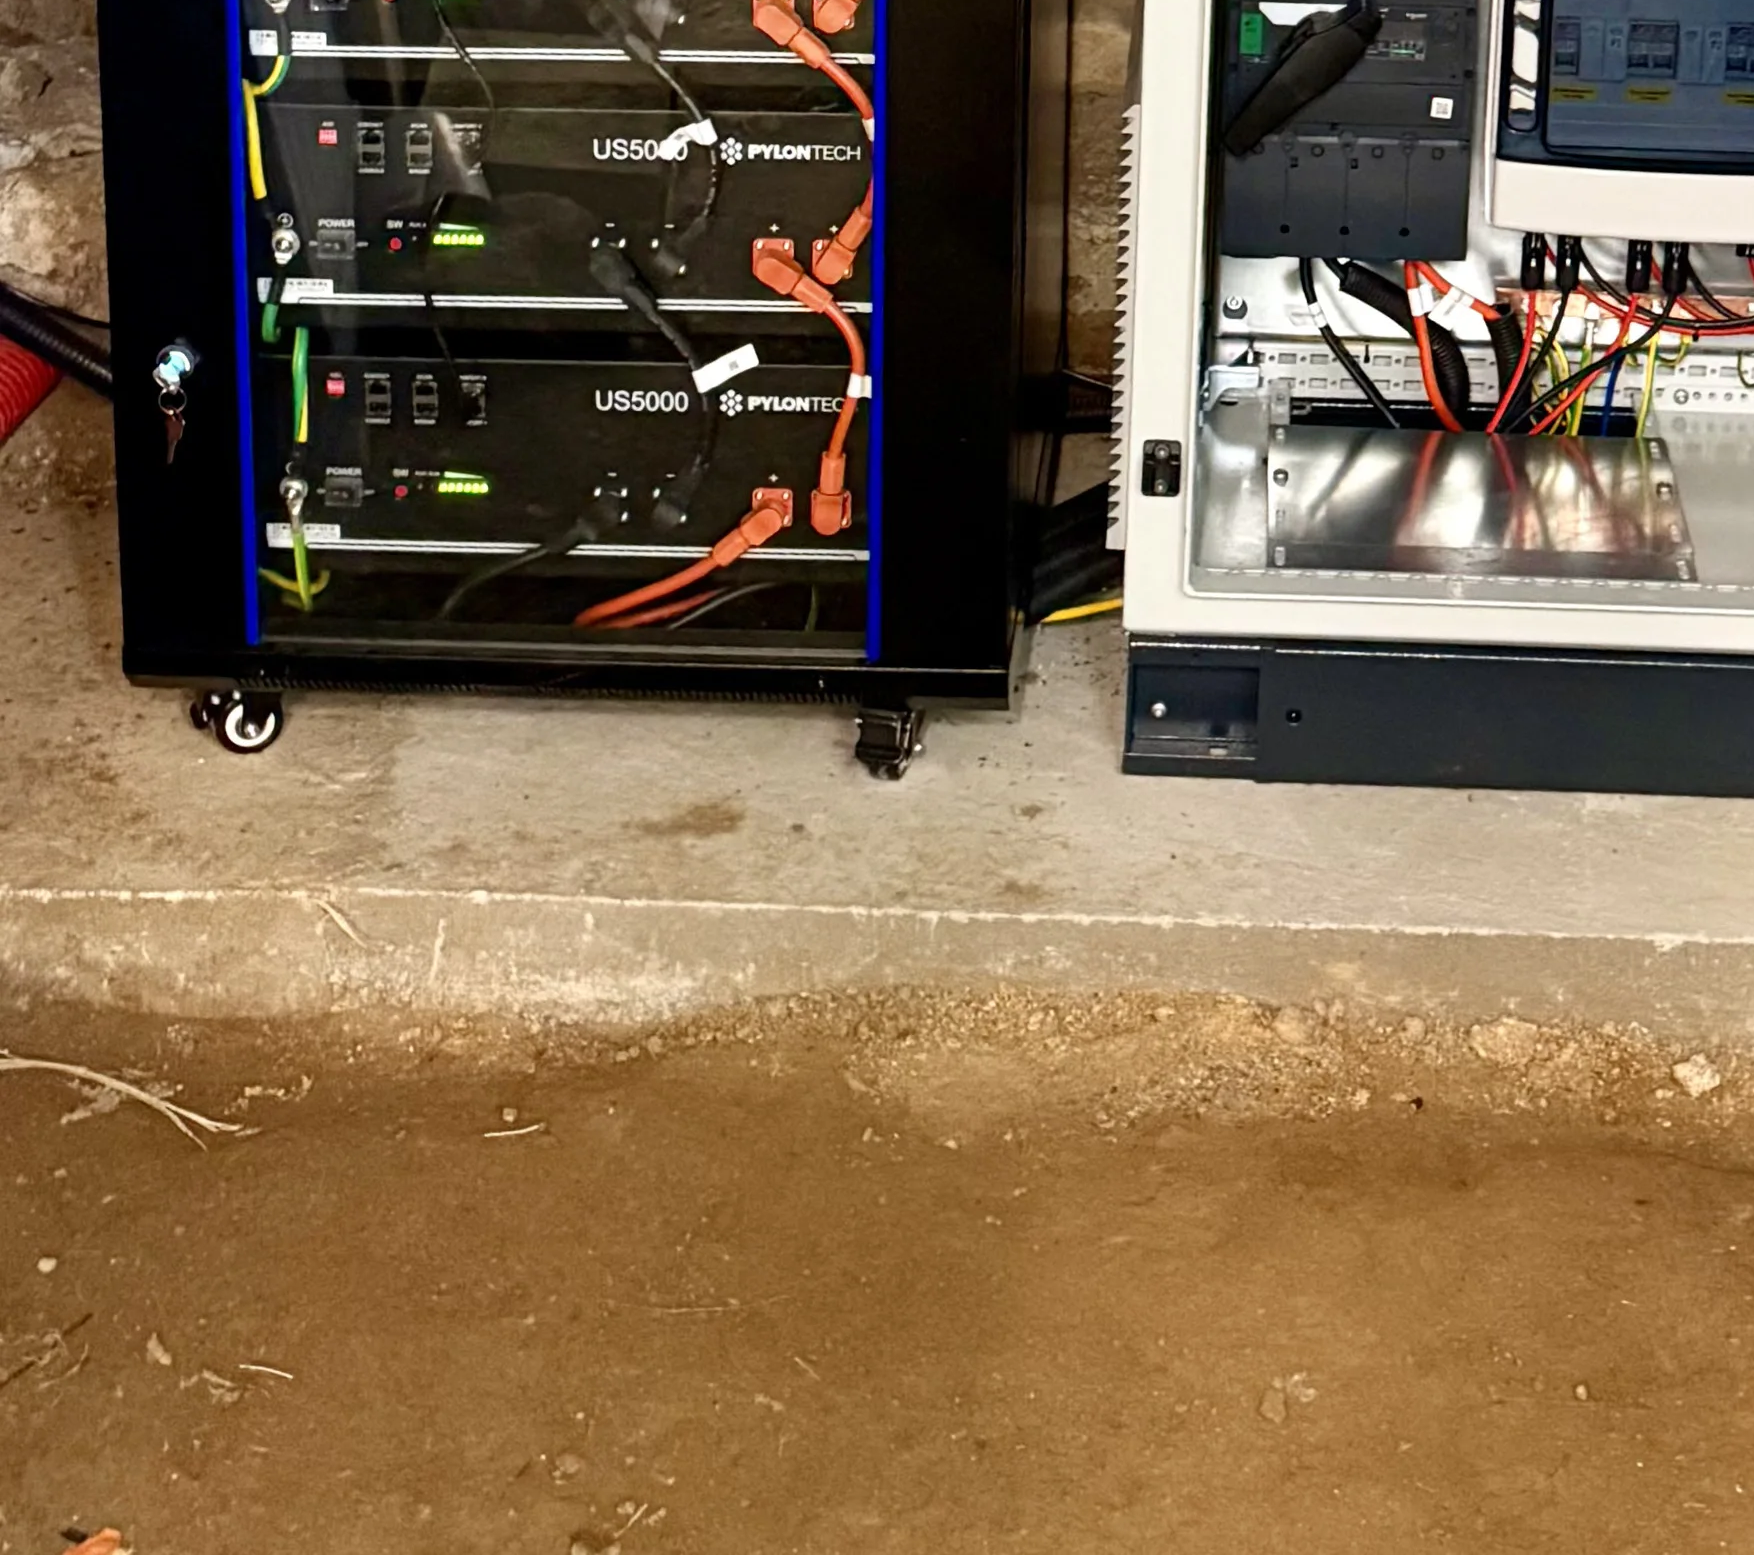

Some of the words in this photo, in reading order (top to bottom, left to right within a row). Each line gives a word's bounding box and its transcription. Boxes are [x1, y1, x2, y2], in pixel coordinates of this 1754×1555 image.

[592, 138, 689, 162] US500
[747, 144, 861, 161] PYLONTECH
[317, 218, 355, 228] POWER
[386, 219, 404, 229] SW
[595, 390, 689, 412] US5000
[747, 396, 846, 413] PYLONTEC
[325, 466, 363, 476] POWER
